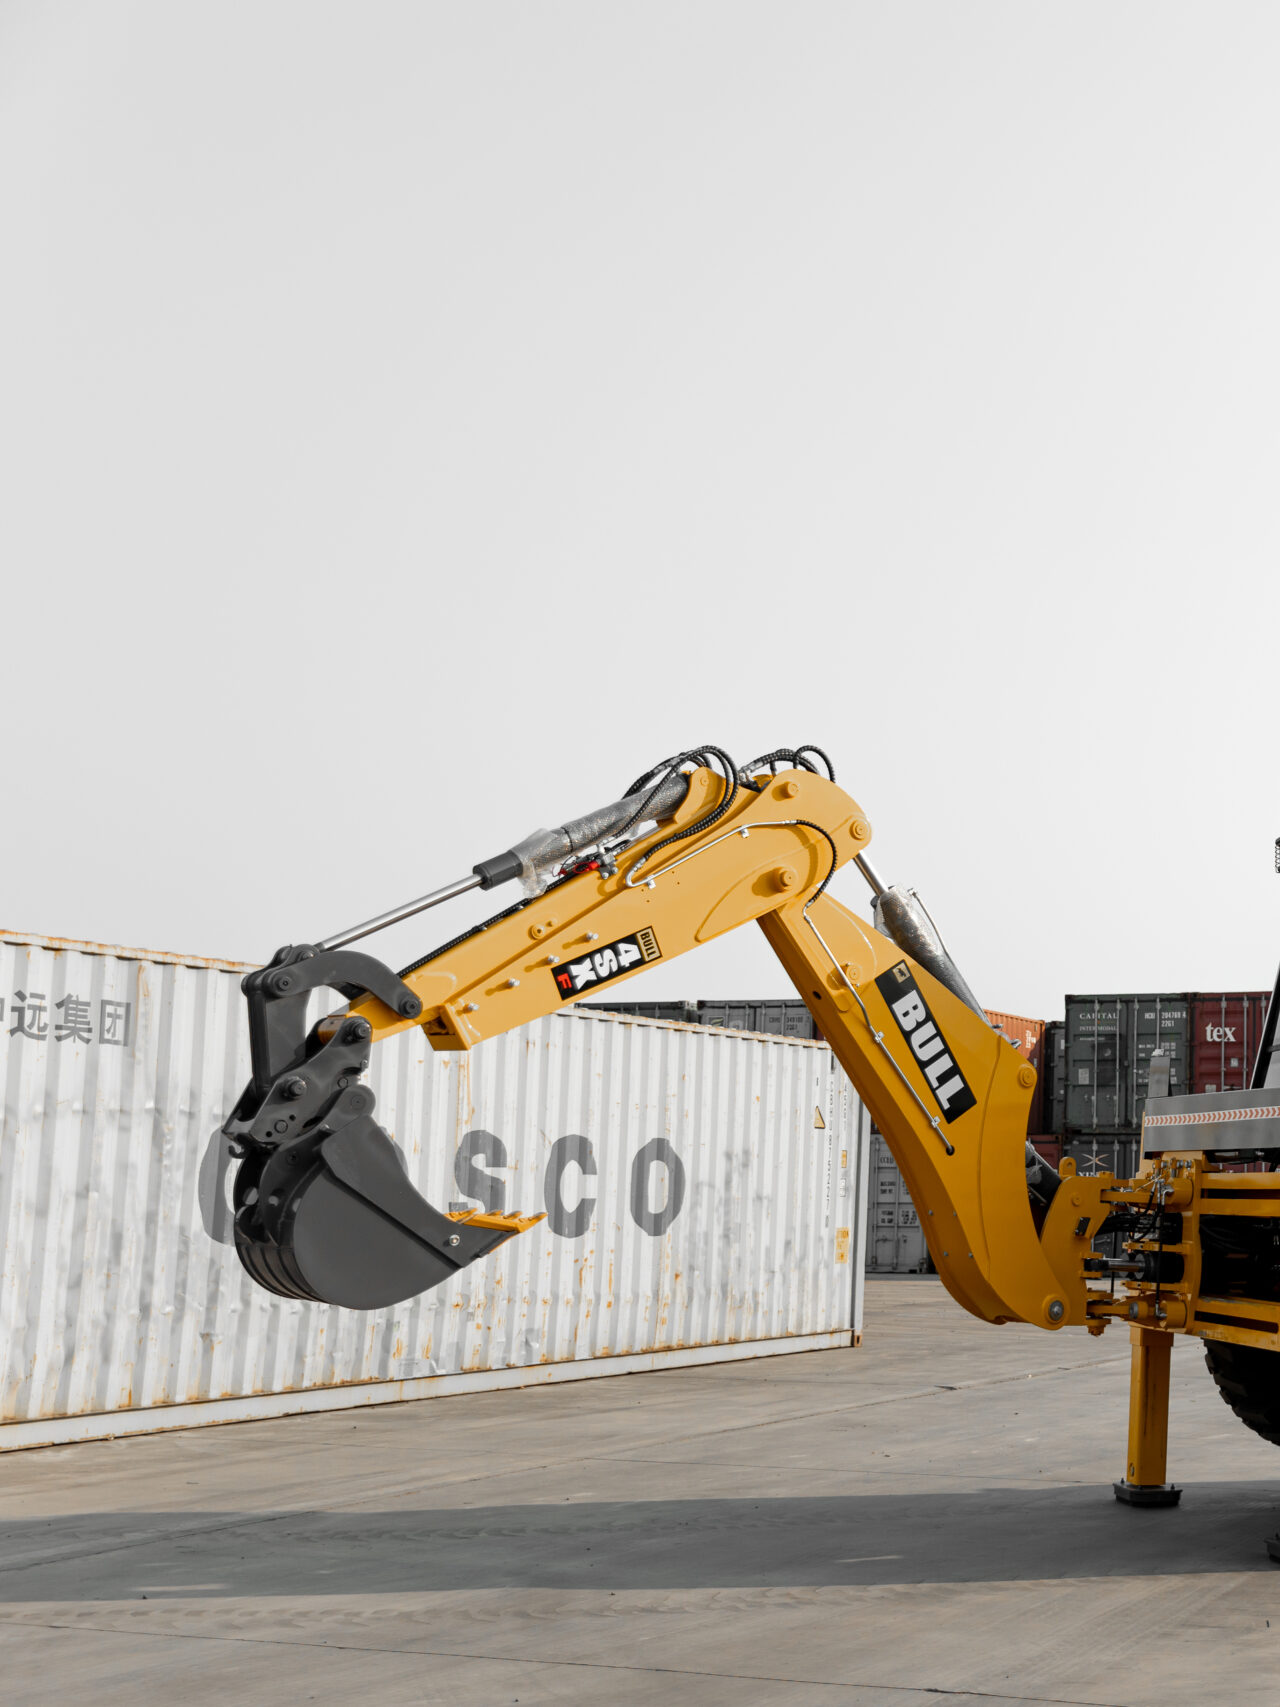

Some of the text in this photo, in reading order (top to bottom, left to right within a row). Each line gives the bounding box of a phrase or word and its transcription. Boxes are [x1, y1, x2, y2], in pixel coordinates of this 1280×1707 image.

[569, 943, 641, 990] 4SX
[640, 931, 657, 958] BULL
[0, 990, 131, 1047] 远集团
[1205, 1022, 1237, 1042] tex
[892, 989, 965, 1110] BULL
